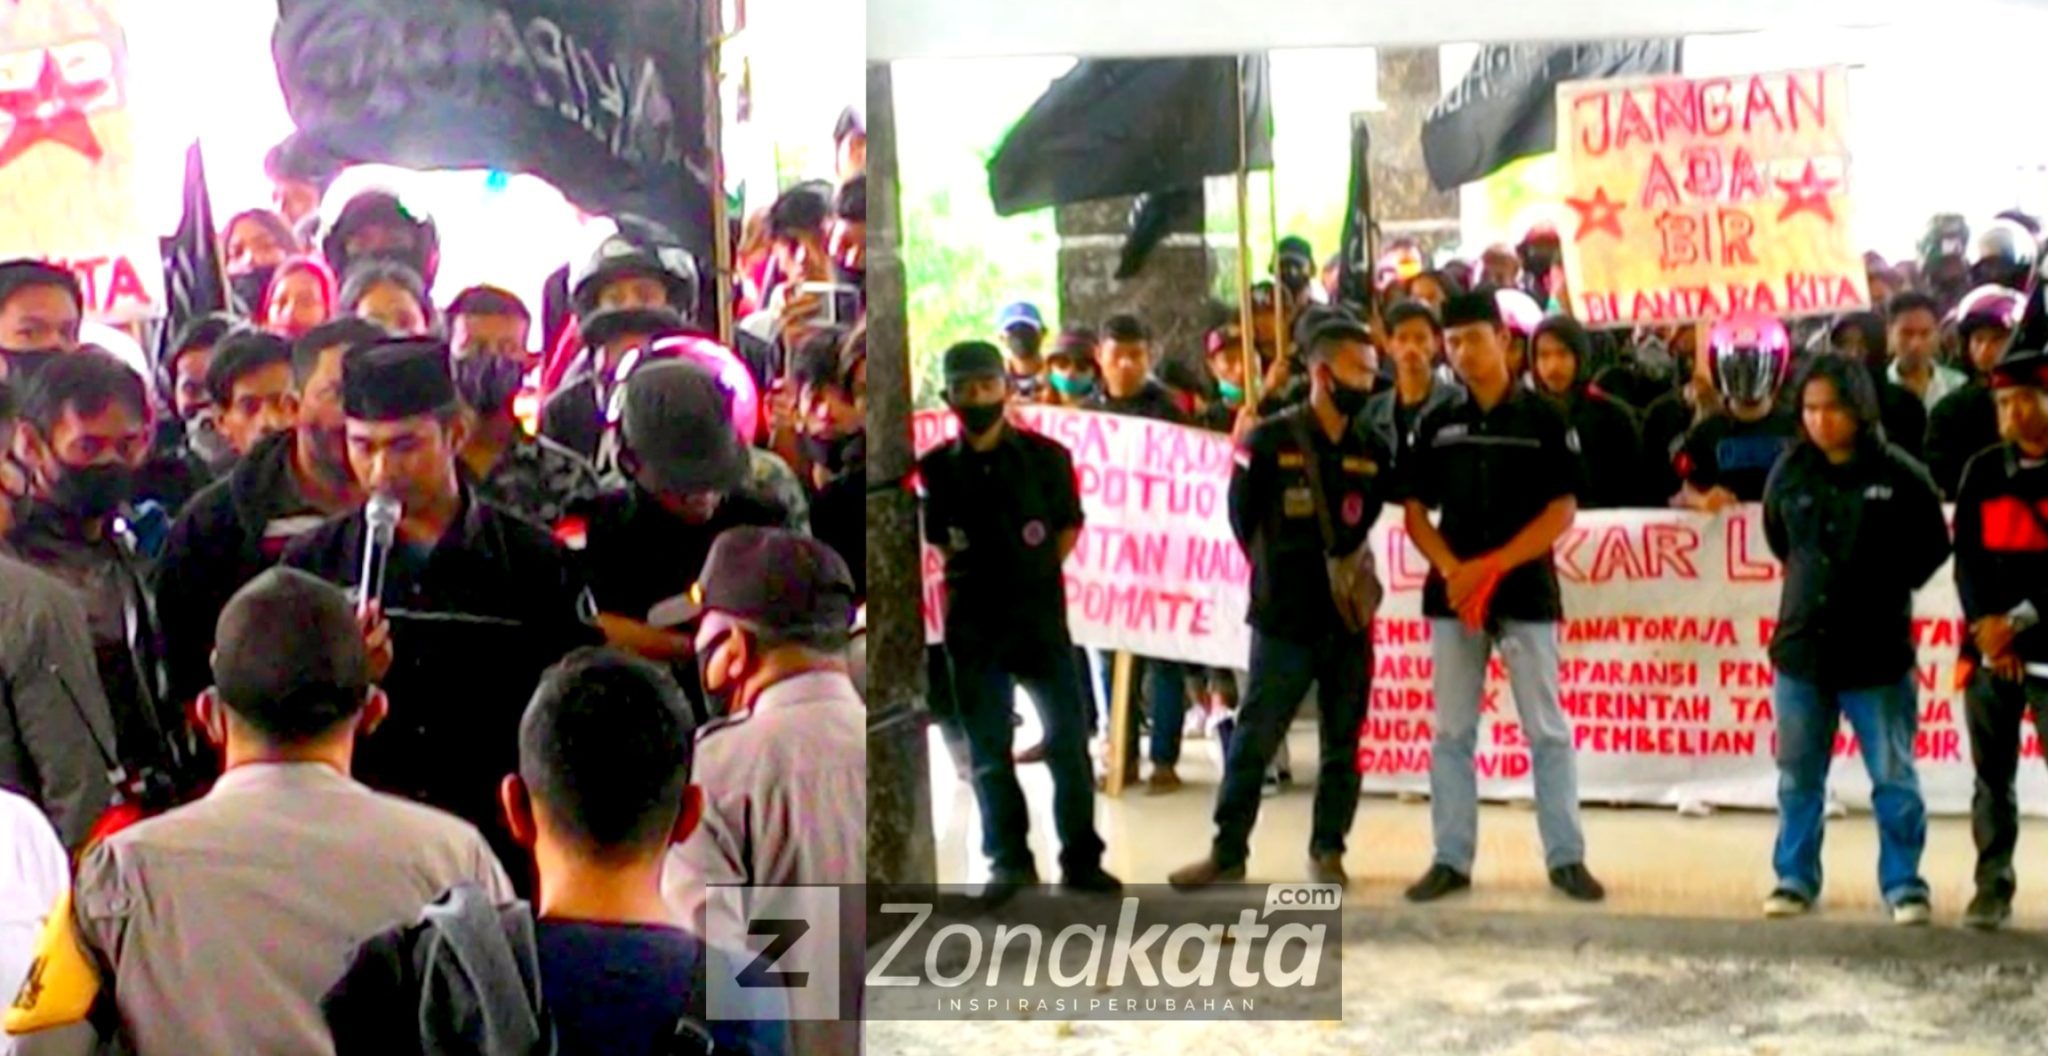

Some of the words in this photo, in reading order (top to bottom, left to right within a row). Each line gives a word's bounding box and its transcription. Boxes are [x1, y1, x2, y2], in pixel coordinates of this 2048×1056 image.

[1574, 70, 1826, 157] JANGAN
[1642, 145, 1765, 209] ADA
[1655, 208, 1759, 270] BIR
[1633, 281, 1776, 321] ANTARA
[1786, 272, 1862, 312] KITA
[1075, 463, 1216, 519] POTUO
[1063, 574, 1215, 635] POMATE
[1574, 724, 1755, 755] PEMBELIAN
